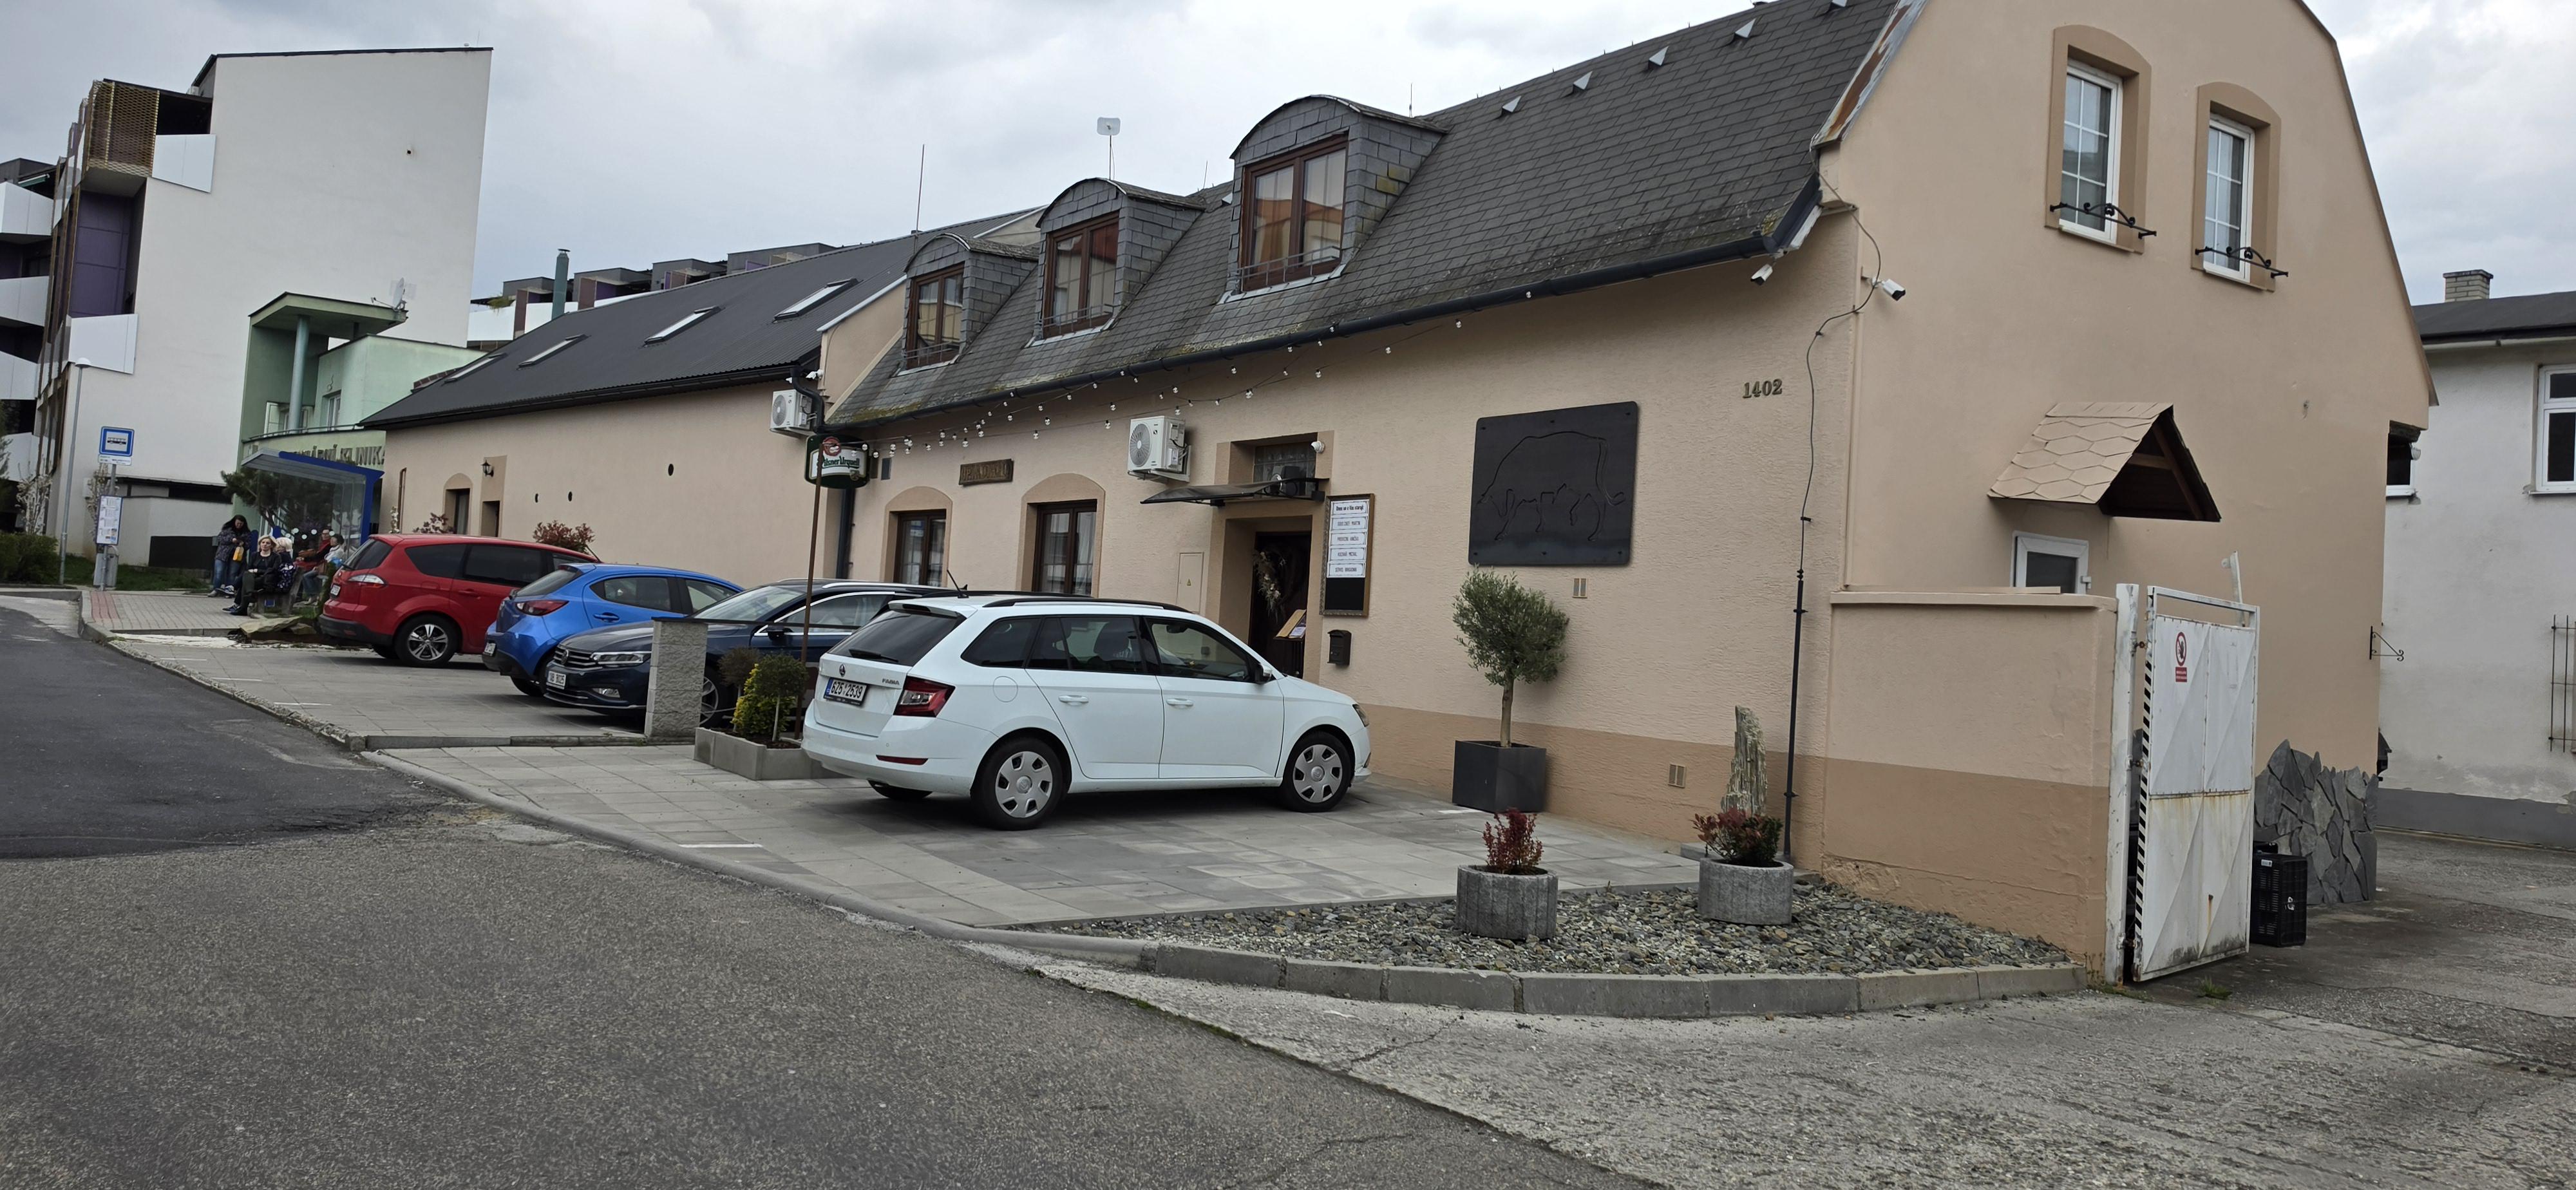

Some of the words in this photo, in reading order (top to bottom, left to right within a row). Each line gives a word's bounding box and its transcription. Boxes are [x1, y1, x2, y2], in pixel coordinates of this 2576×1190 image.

[1742, 378, 1783, 399] 1402
[831, 681, 844, 695] 6Z5
[845, 684, 863, 698] 2539
